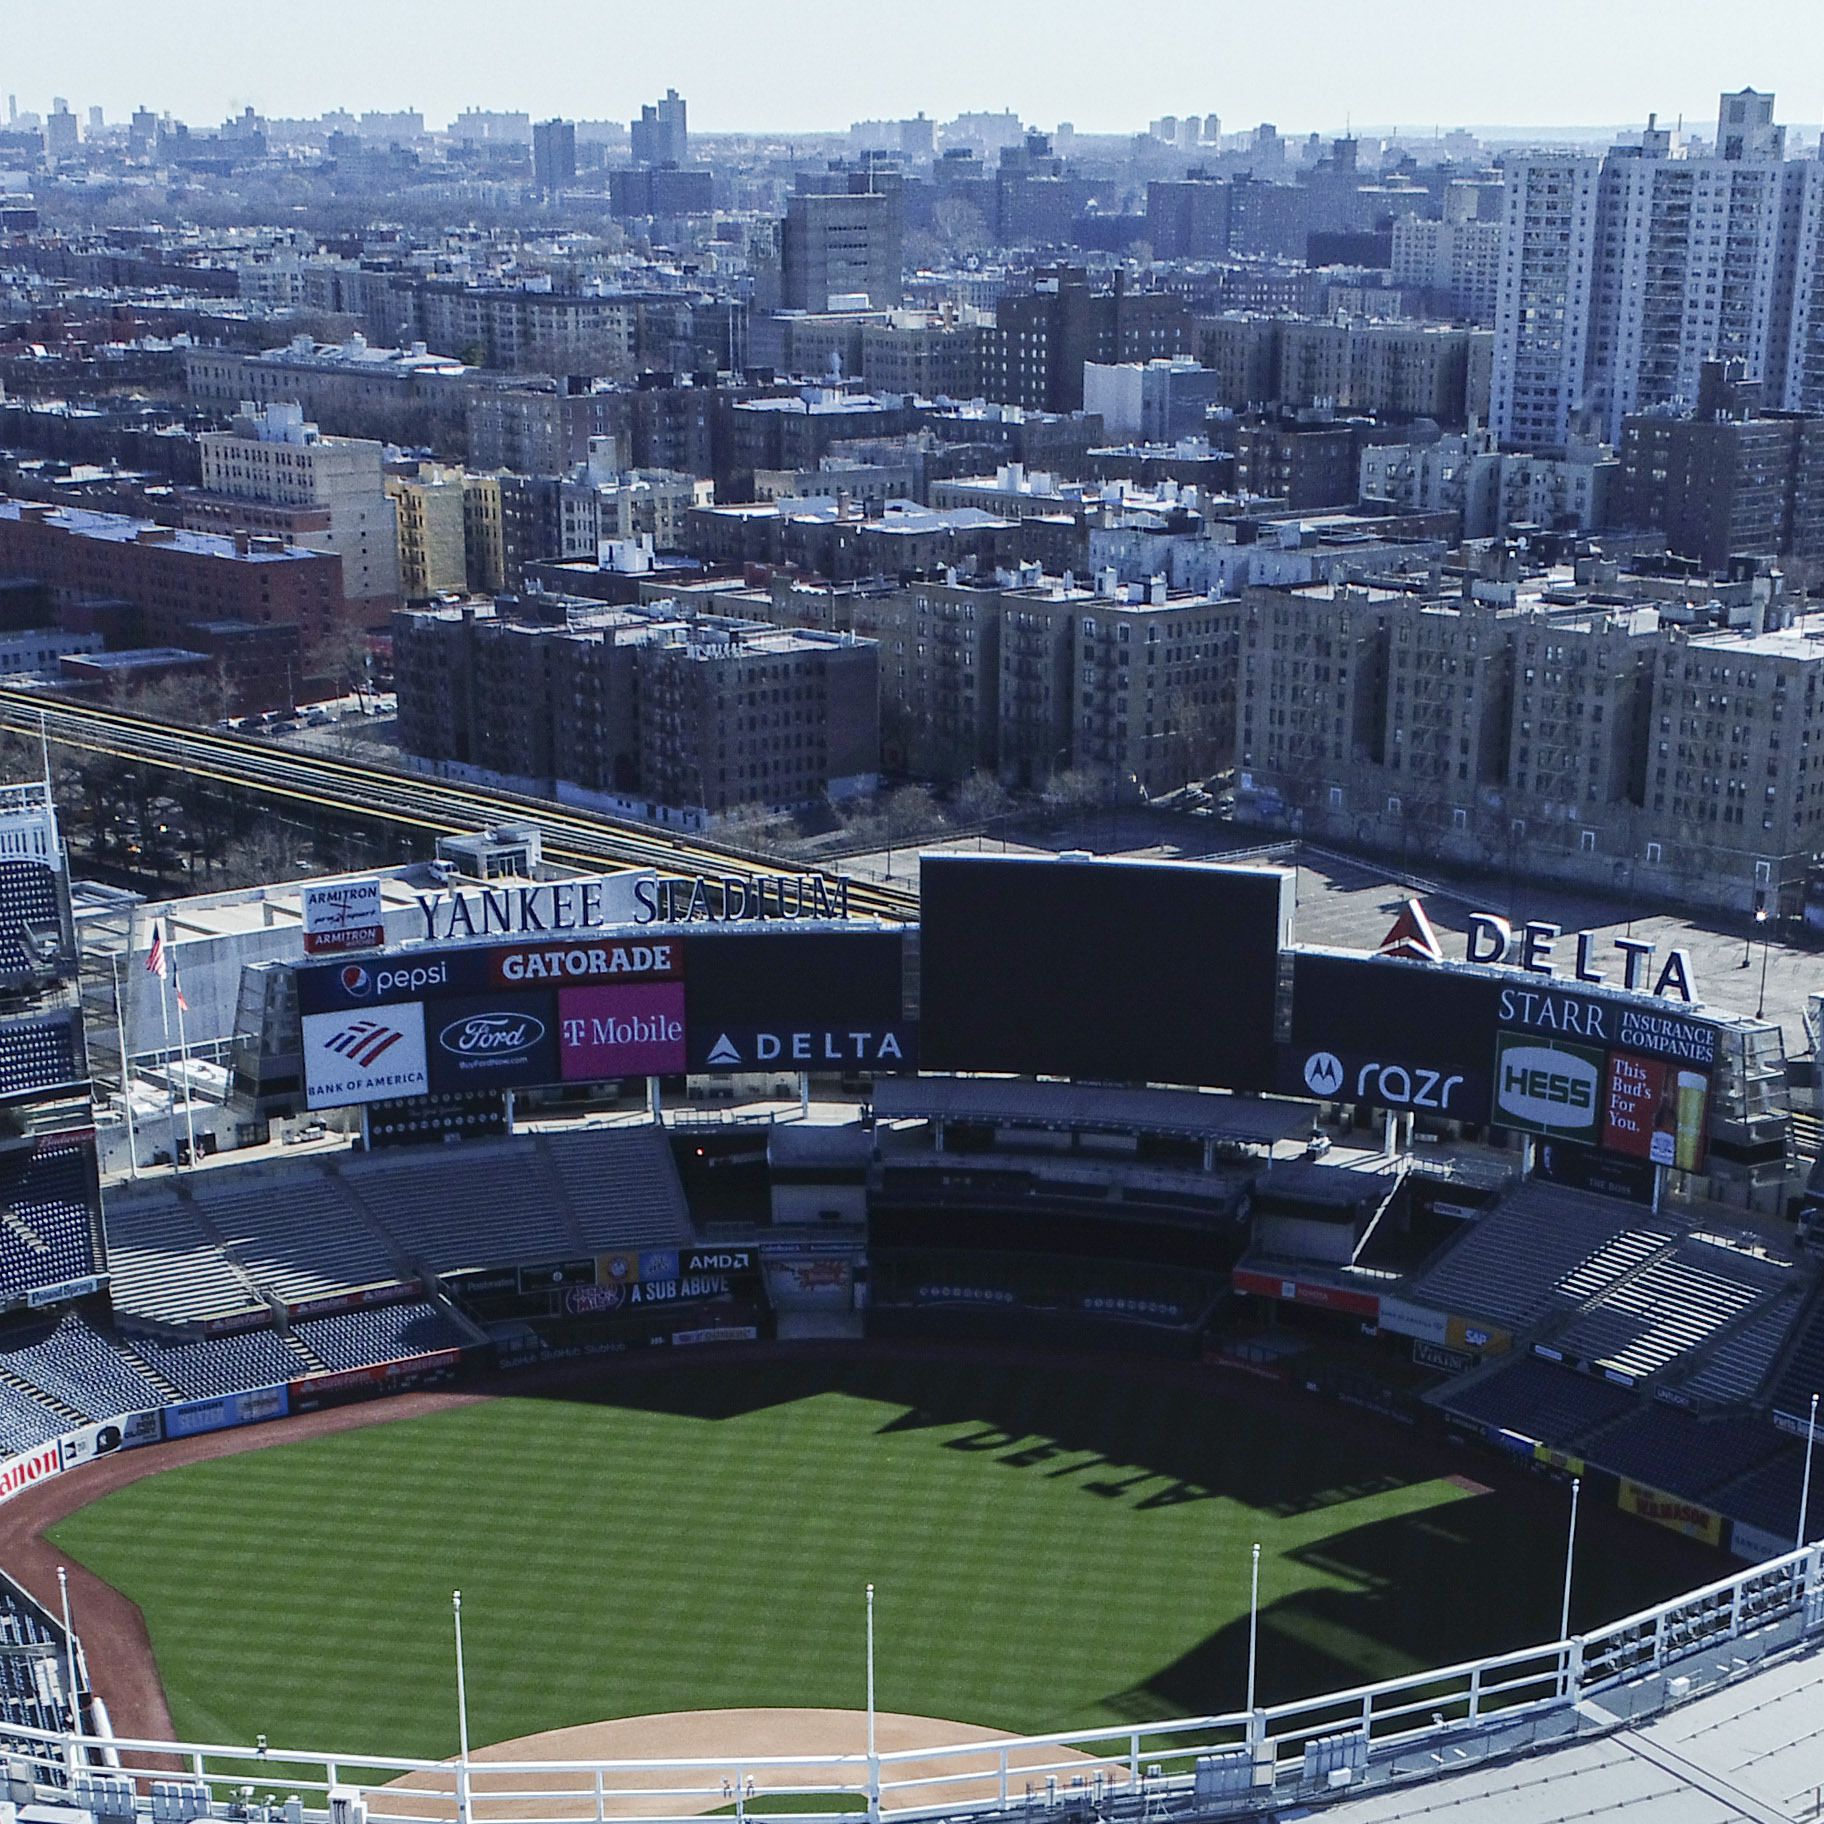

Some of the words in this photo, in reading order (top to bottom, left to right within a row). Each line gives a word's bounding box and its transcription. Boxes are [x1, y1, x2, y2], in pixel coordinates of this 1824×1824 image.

[308, 886, 378, 906] ARMITRON
[411, 883, 605, 940] YANKEE
[633, 873, 853, 926] STADIUM
[315, 928, 376, 945] ARMITRON
[502, 945, 672, 980] GATORADE
[1466, 911, 1699, 1003] DELTA
[376, 960, 448, 995] pepsi
[1498, 988, 1608, 1040] STARR
[1621, 1010, 1715, 1046] INSURANCE
[458, 1018, 525, 1050] Ford
[592, 1015, 683, 1045] Mobile
[1620, 1027, 1714, 1063] COMPANIES
[756, 1031, 904, 1061] DELTA
[308, 1080, 345, 1098] BANK
[346, 1077, 365, 1091] OF
[366, 1071, 425, 1089] AMERICA
[1614, 1058, 1648, 1081] This
[1356, 1062, 1464, 1109] razr
[1504, 1064, 1591, 1109] HESS
[1612, 1076, 1652, 1100] Bud's
[1610, 1094, 1636, 1114] For
[1609, 1111, 1641, 1133] You.
[688, 1255, 732, 1270] AMD
[630, 1284, 642, 1303] A
[645, 1280, 676, 1299] SUB
[680, 1275, 730, 1297] ABOVE
[1465, 1328, 1488, 1346] SAP
